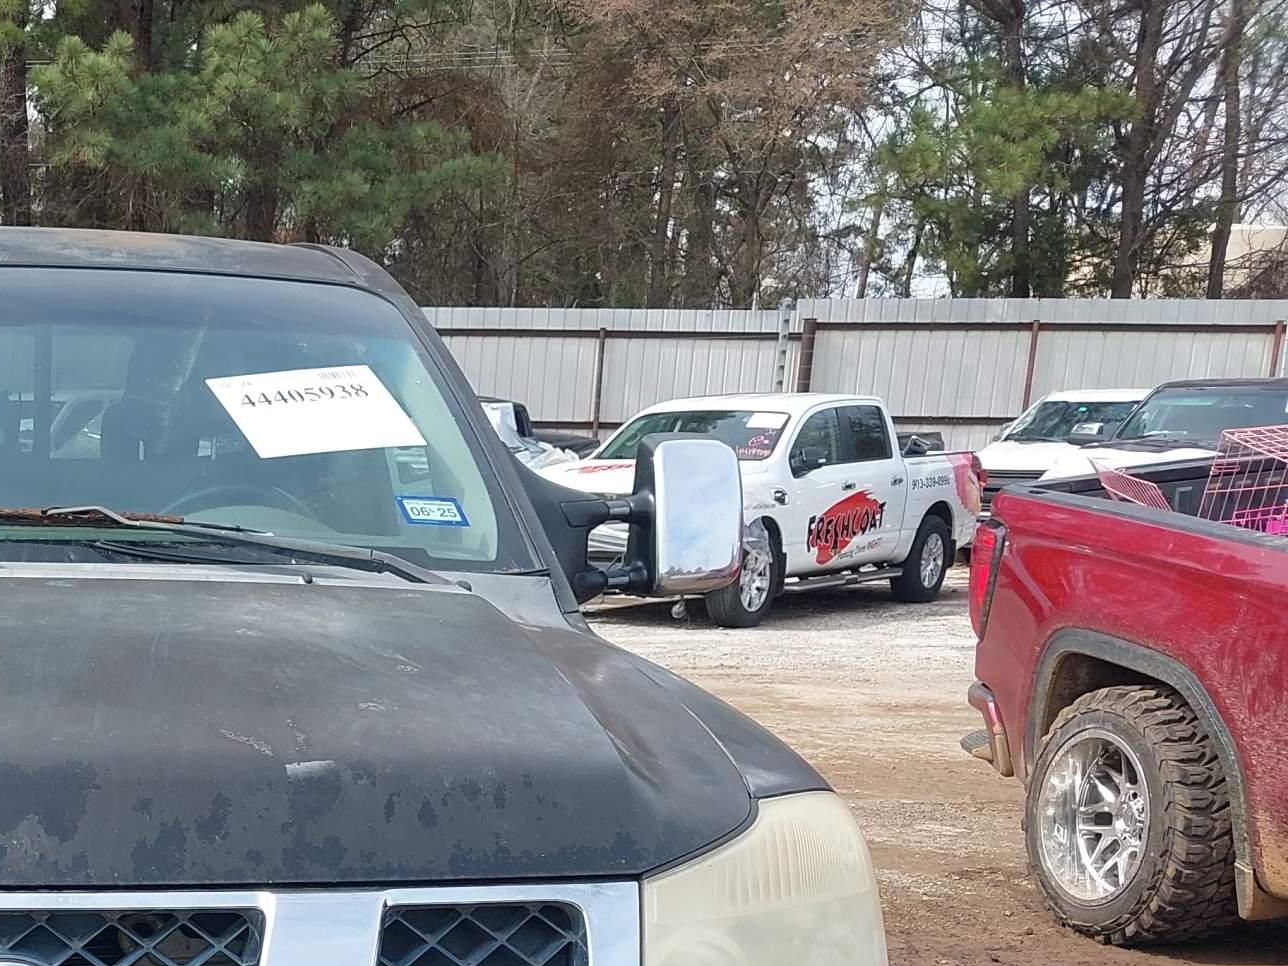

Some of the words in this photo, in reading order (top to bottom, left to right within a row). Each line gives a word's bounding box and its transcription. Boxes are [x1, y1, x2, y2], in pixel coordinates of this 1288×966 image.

[241, 384, 369, 407] 44405938
[410, 506, 431, 517] 06
[437, 508, 457, 518] 25
